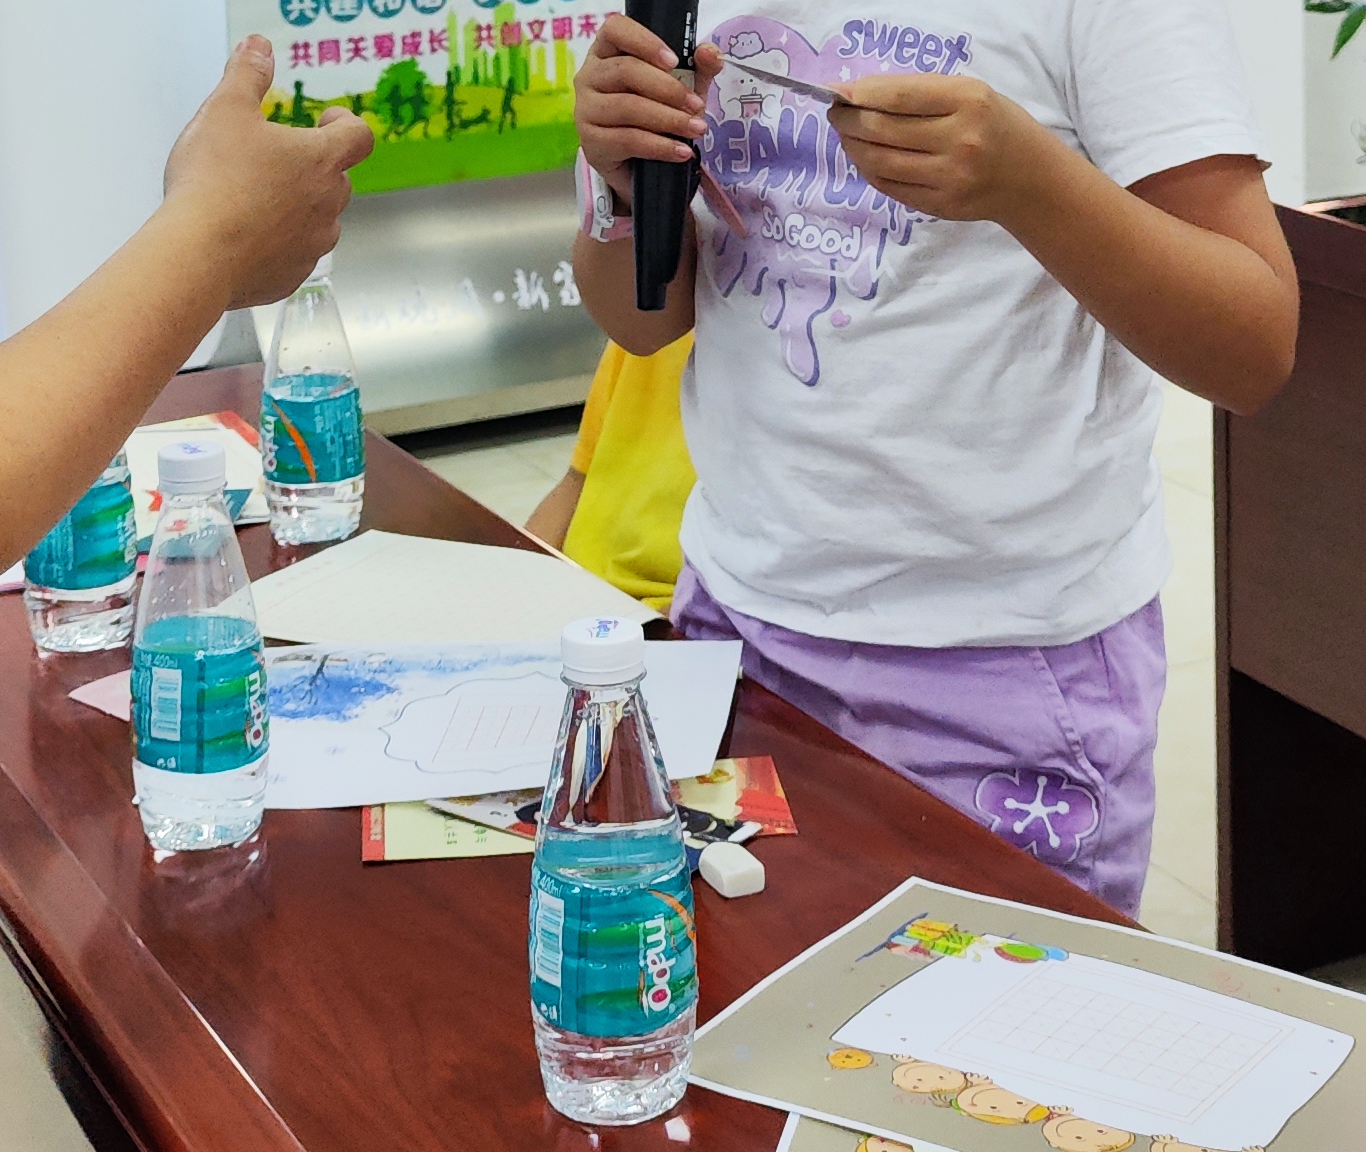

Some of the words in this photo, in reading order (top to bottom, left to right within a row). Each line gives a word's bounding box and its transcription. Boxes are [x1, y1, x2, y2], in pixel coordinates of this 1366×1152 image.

[290, 28, 450, 69] 共同关爱成长
[473, 11, 622, 51] 共创文明未
[837, 18, 972, 76] sweet
[699, 106, 820, 206] REAM
